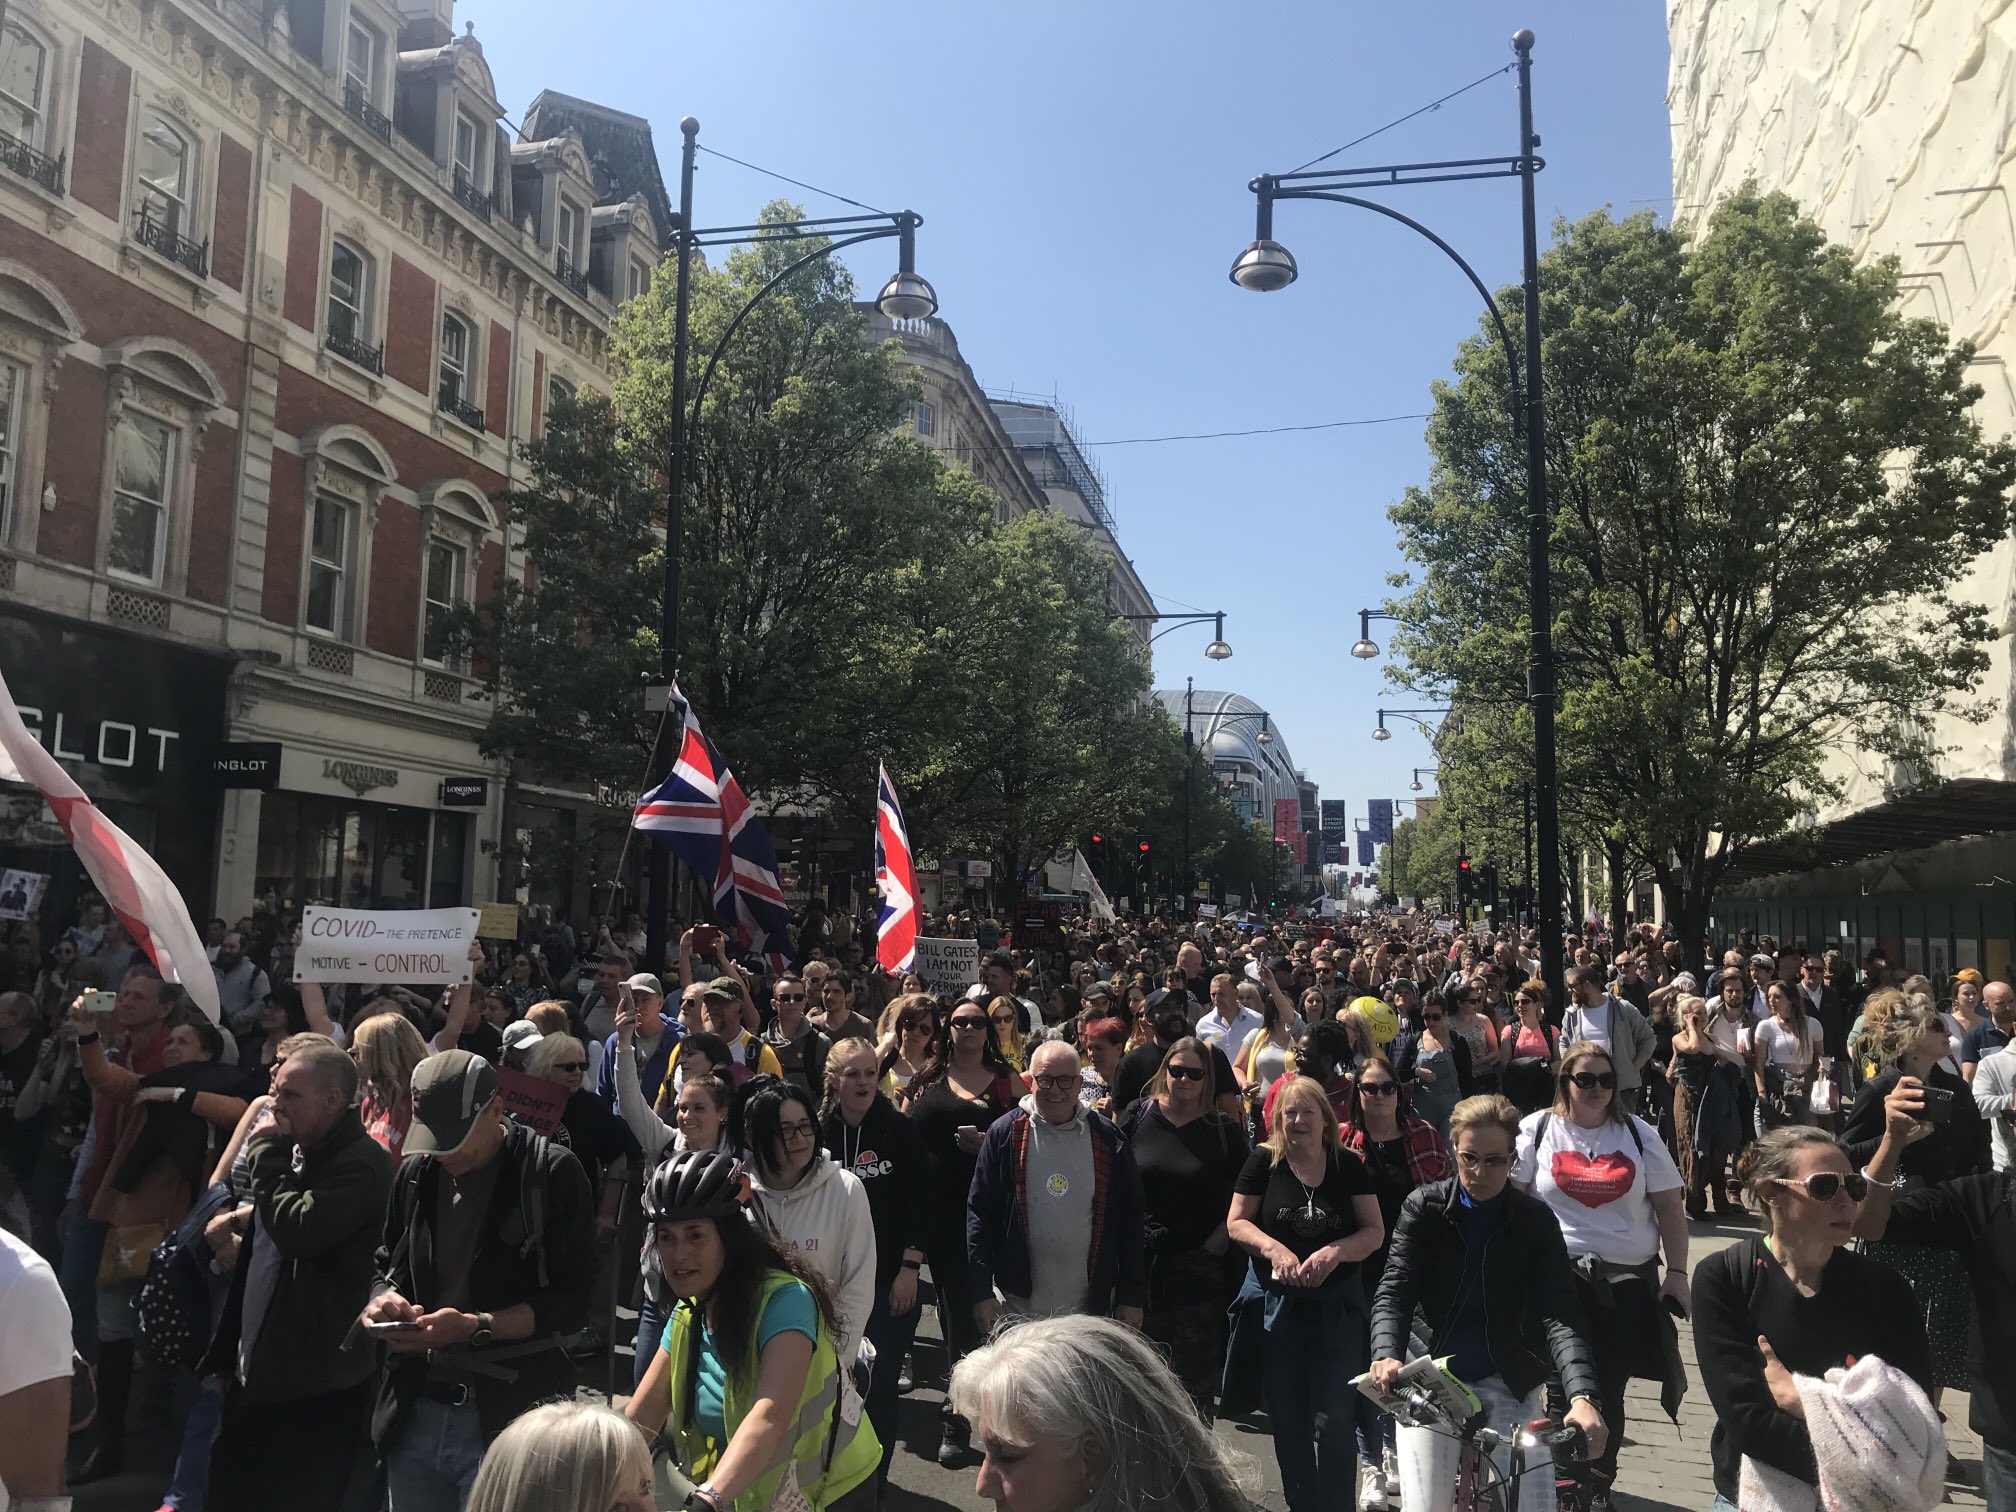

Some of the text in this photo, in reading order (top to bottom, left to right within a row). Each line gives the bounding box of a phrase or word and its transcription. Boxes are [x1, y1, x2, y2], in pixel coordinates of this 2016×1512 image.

[213, 760, 268, 771] INGLOT
[321, 758, 399, 788] LONGINES
[1016, 902, 1057, 920] FEAR
[385, 929, 404, 939] THE
[407, 927, 462, 940] PRETENCE
[917, 943, 940, 957] BILL
[311, 956, 351, 970] MOTIVE
[374, 953, 451, 973] CONTROL
[926, 959, 973, 972] I AM NOT
[938, 971, 962, 980] YOUR
[1371, 1022, 1393, 1035] KIDS
[507, 1090, 556, 1113] DIDN'T
[805, 1238, 819, 1251] 21
